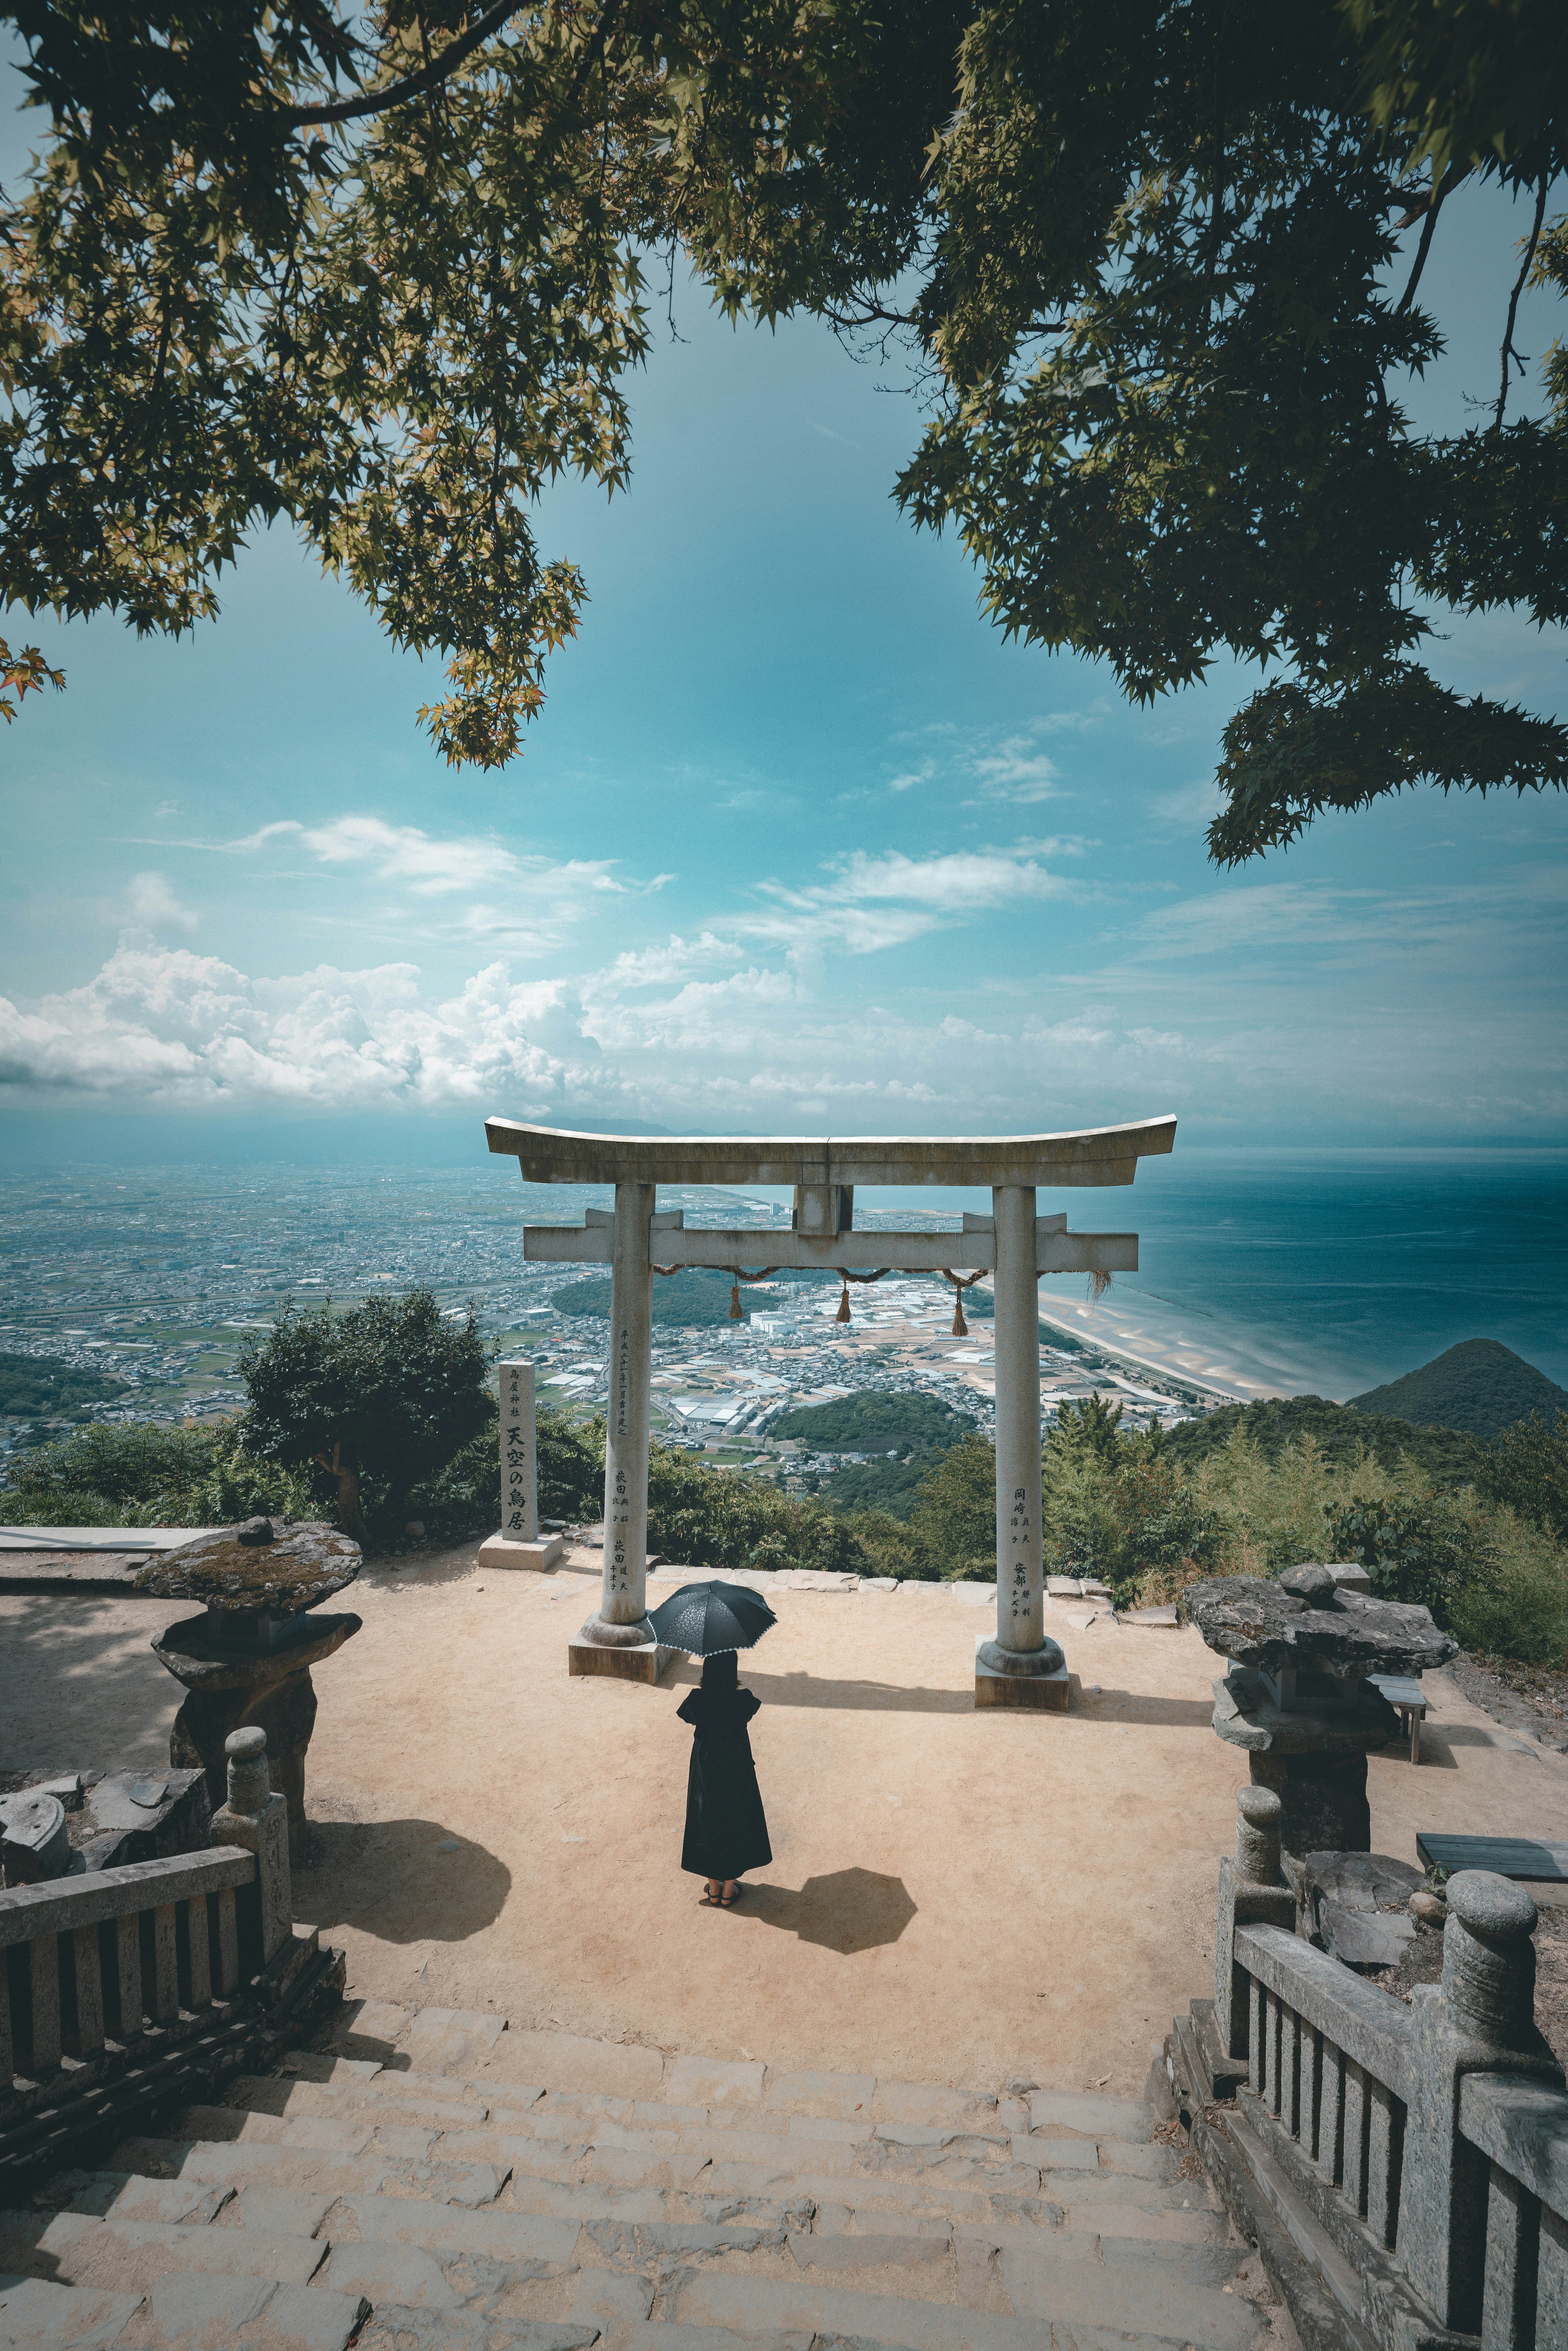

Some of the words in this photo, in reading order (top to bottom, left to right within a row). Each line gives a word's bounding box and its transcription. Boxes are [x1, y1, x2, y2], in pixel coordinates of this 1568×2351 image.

[509, 1369, 520, 1417] 高屋神社
[617, 1330, 629, 1435] 平成二十一年一月吉日建之
[506, 1426, 526, 1530] 天空の鳥居
[612, 1497, 619, 1522] 良子
[620, 1498, 629, 1522] 典昭
[1010, 1517, 1019, 1544] 淳子
[1021, 1517, 1030, 1543] 貞夫
[619, 1566, 628, 1591] 道夫
[1013, 1562, 1027, 1587] 安部
[1011, 1590, 1019, 1616] チズ子
[1022, 1590, 1031, 1616] 勝利
